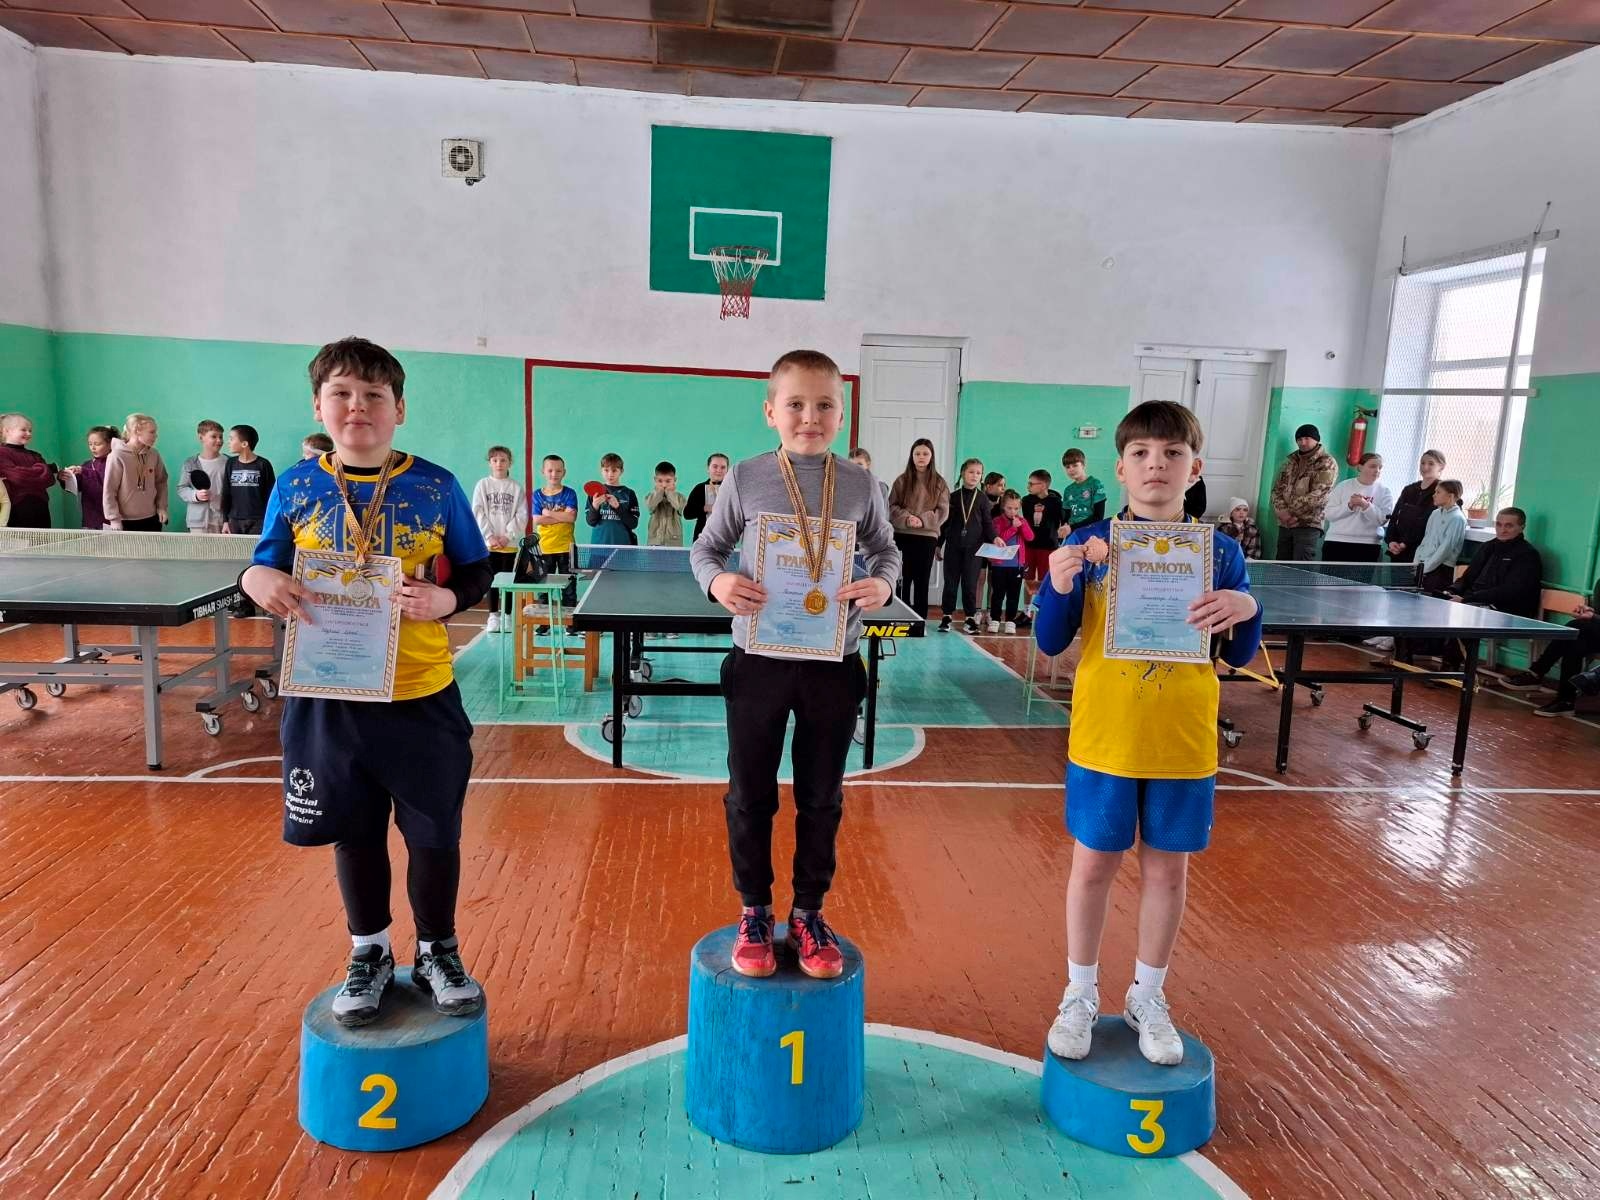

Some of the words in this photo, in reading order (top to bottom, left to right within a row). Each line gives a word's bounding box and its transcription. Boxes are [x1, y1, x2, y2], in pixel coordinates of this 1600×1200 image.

[776, 554, 834, 571] ГРАМА
[1130, 562, 1194, 575] ГРАМОТА
[192, 601, 216, 619] TIBHAR
[216, 594, 233, 610] SMASH
[863, 625, 910, 637] NIC
[286, 792, 318, 807] Special
[289, 812, 314, 825] Ukraine
[780, 1030, 805, 1085] 1
[358, 1073, 397, 1129] 2
[1126, 1099, 1165, 1154] 3
